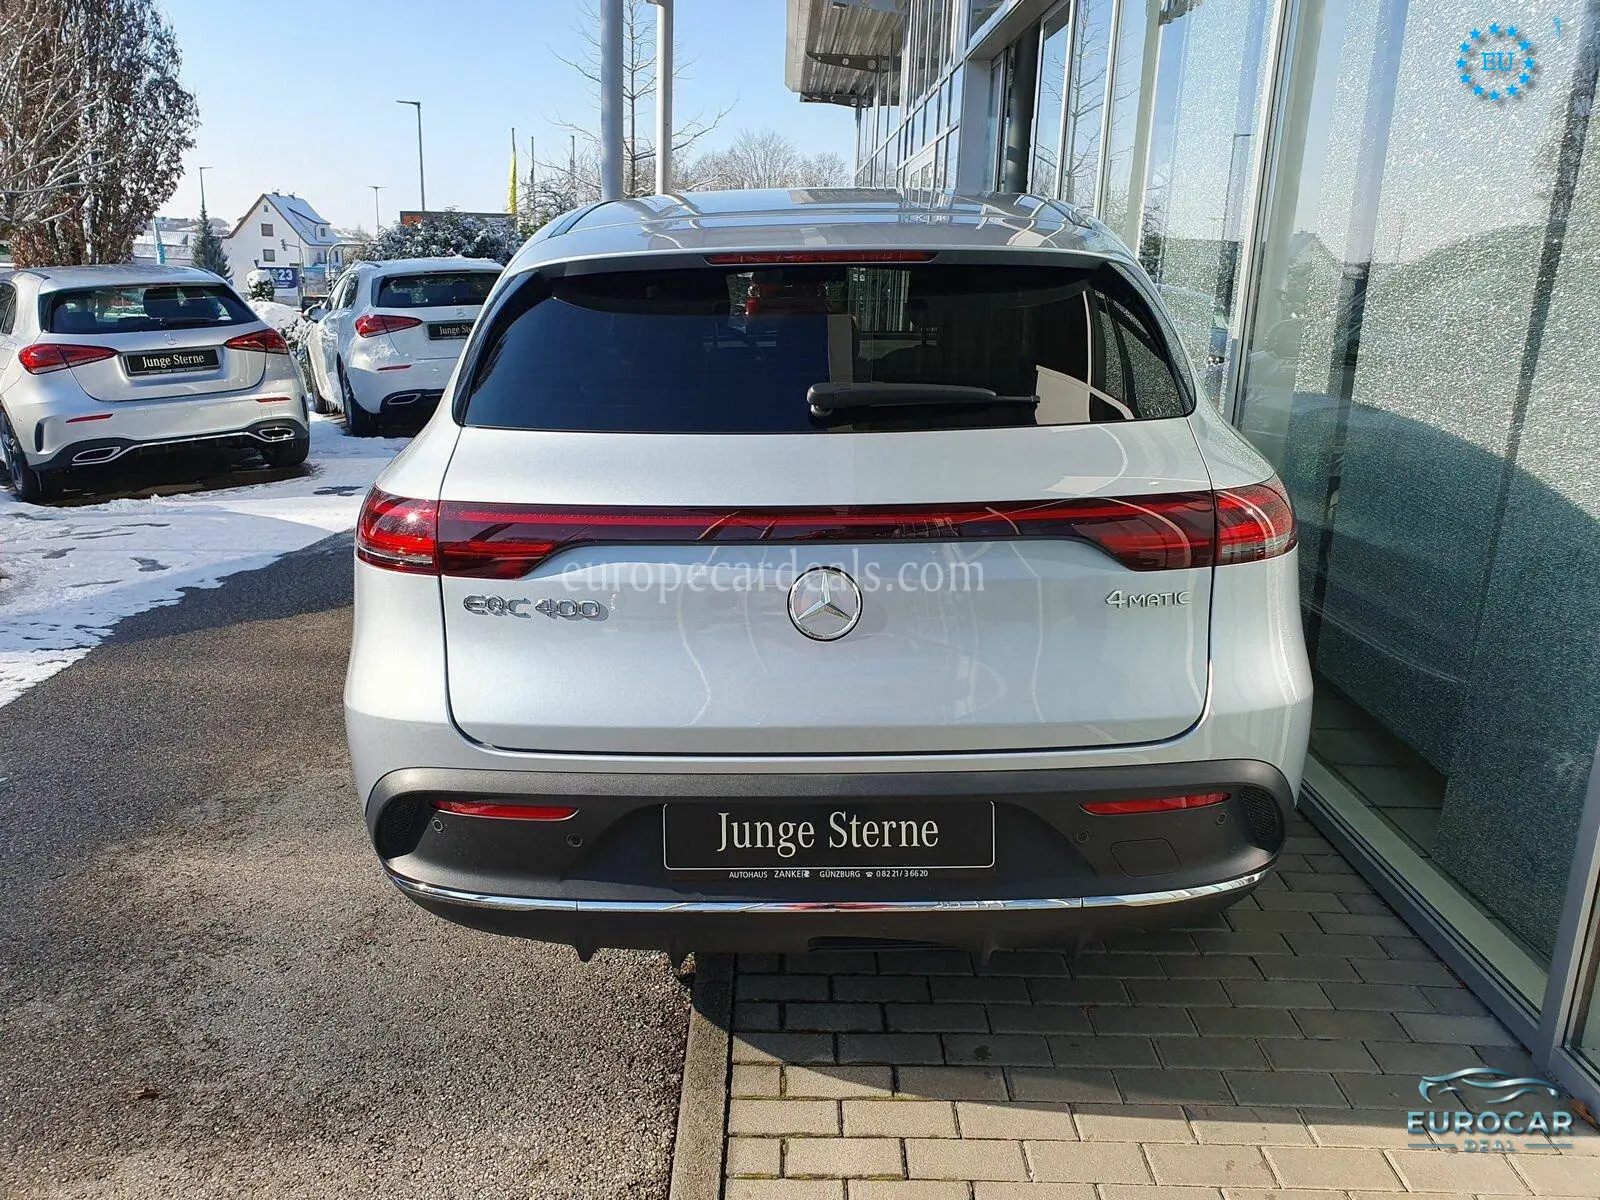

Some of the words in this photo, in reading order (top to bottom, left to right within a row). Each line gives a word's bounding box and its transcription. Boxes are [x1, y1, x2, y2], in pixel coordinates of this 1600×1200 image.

[142, 356, 172, 369] Junge
[172, 354, 205, 365] Sterne
[463, 594, 531, 618] EQC
[535, 598, 602, 619] 400
[717, 812, 815, 858] Junge
[829, 811, 939, 849] Sterne
[728, 870, 768, 879] AUTOHAUS
[819, 868, 861, 878] GÜNZBURG
